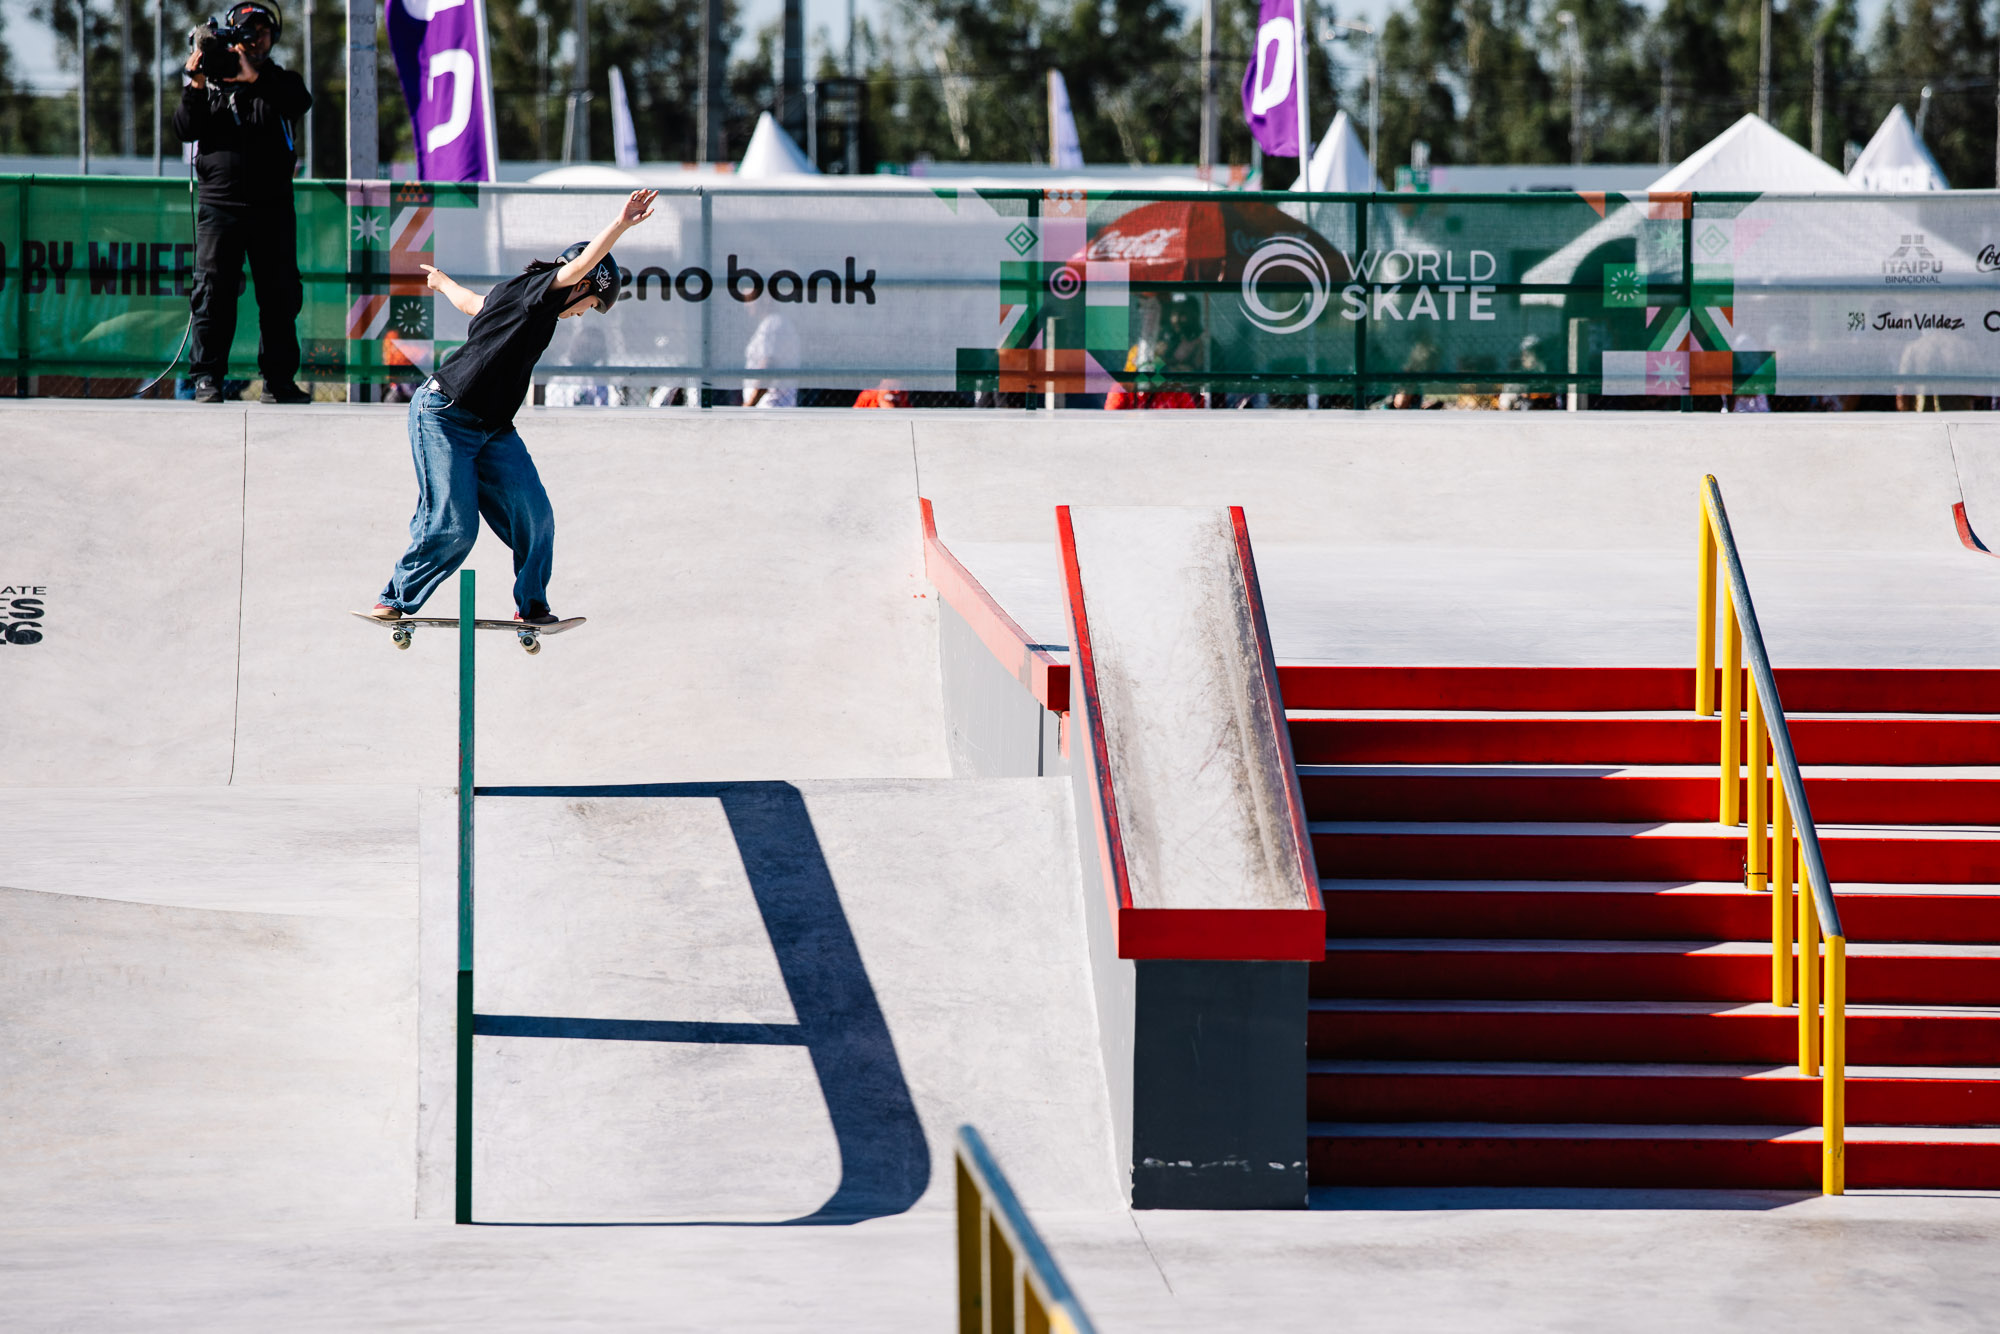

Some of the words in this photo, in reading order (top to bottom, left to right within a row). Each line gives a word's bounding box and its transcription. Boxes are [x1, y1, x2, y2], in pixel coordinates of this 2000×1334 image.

[23, 241, 73, 294] BY
[88, 241, 246, 296] WHEE
[727, 254, 876, 305] bank
[1341, 250, 1496, 281] WORLD
[1881, 260, 1943, 274] ITAIPU
[1885, 275, 1941, 284] BINACIONAL
[1341, 285, 1496, 320] SKATE
[1872, 312, 1912, 331] Juan
[1914, 313, 1965, 331] Valdez
